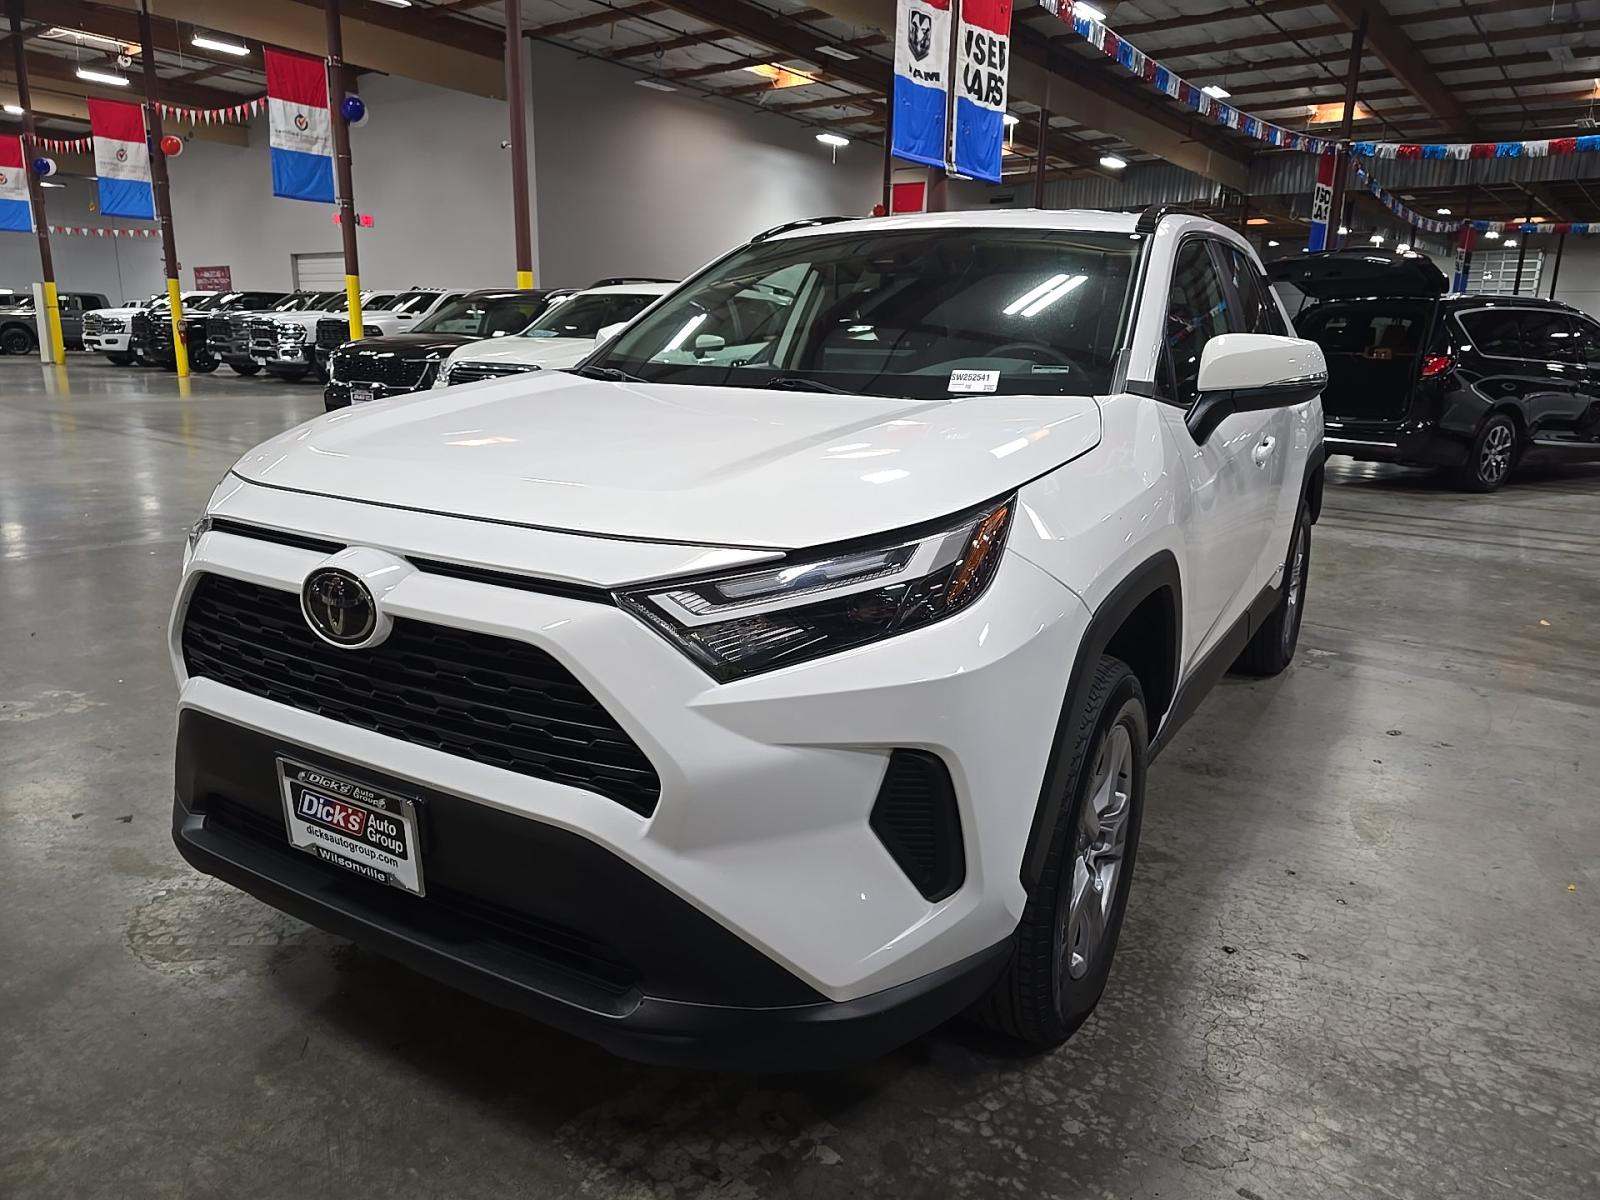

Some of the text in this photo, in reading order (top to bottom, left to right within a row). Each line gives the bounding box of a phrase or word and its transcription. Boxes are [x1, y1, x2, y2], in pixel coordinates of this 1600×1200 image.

[951, 373, 990, 382] SW252541
[355, 787, 374, 798] Auto
[302, 794, 397, 836] Dick's Auto
[306, 824, 399, 868] dicksautogroup.com
[367, 826, 403, 854] Group
[318, 847, 386, 882] Wilsonville
